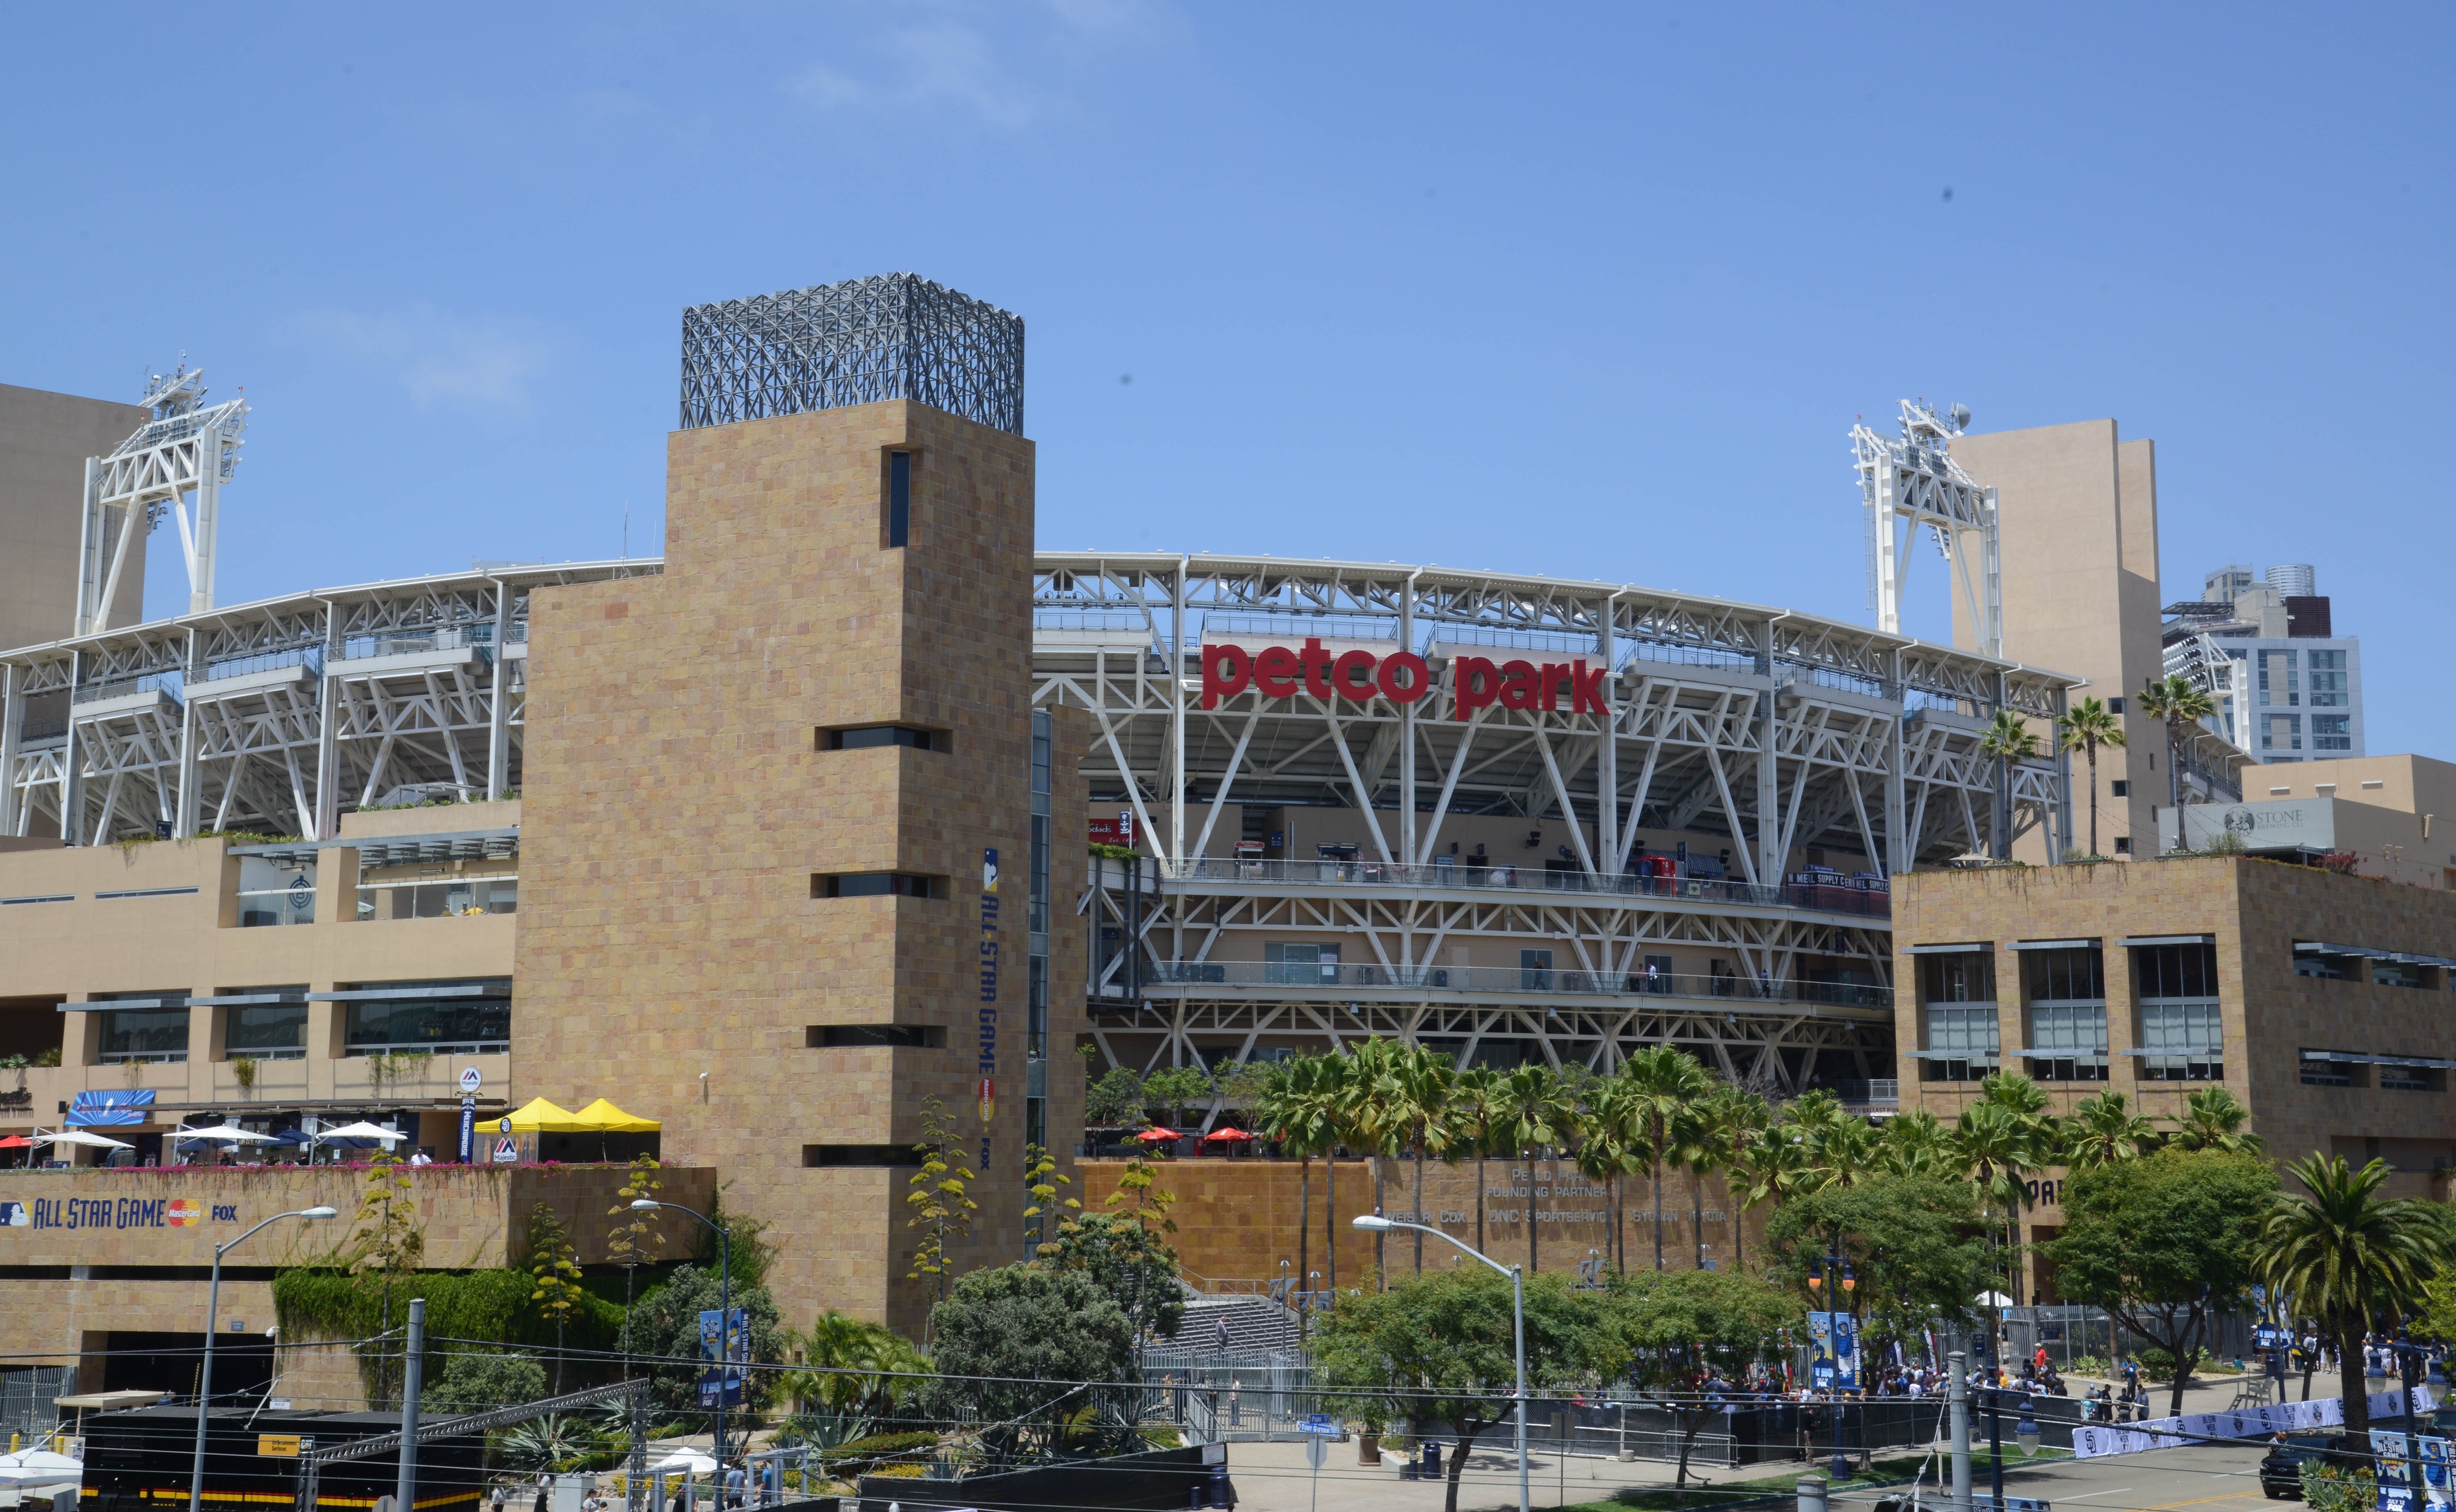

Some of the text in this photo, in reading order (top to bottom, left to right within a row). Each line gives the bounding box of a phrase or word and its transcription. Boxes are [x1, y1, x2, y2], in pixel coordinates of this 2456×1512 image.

[1203, 638, 1610, 721] petco park
[2257, 810, 2303, 824] STONE
[1818, 875, 1838, 885] SUPPLY
[1869, 880, 1885, 890] SUPPLY
[979, 1009, 997, 1074] GAME
[461, 1111, 471, 1157] MERCHANDISE
[981, 1138, 991, 1171] FOX
[1512, 1168, 1552, 1181] PECO
[1554, 1186, 1614, 1198] PARTNER
[116, 1198, 166, 1229] GAME
[168, 1209, 200, 1218] MasterCard
[212, 1205, 237, 1221] FOX
[1489, 1210, 1519, 1223] DNC
[1301, 1423, 1313, 1431] TONY
[300, 1439, 313, 1449] CAT
